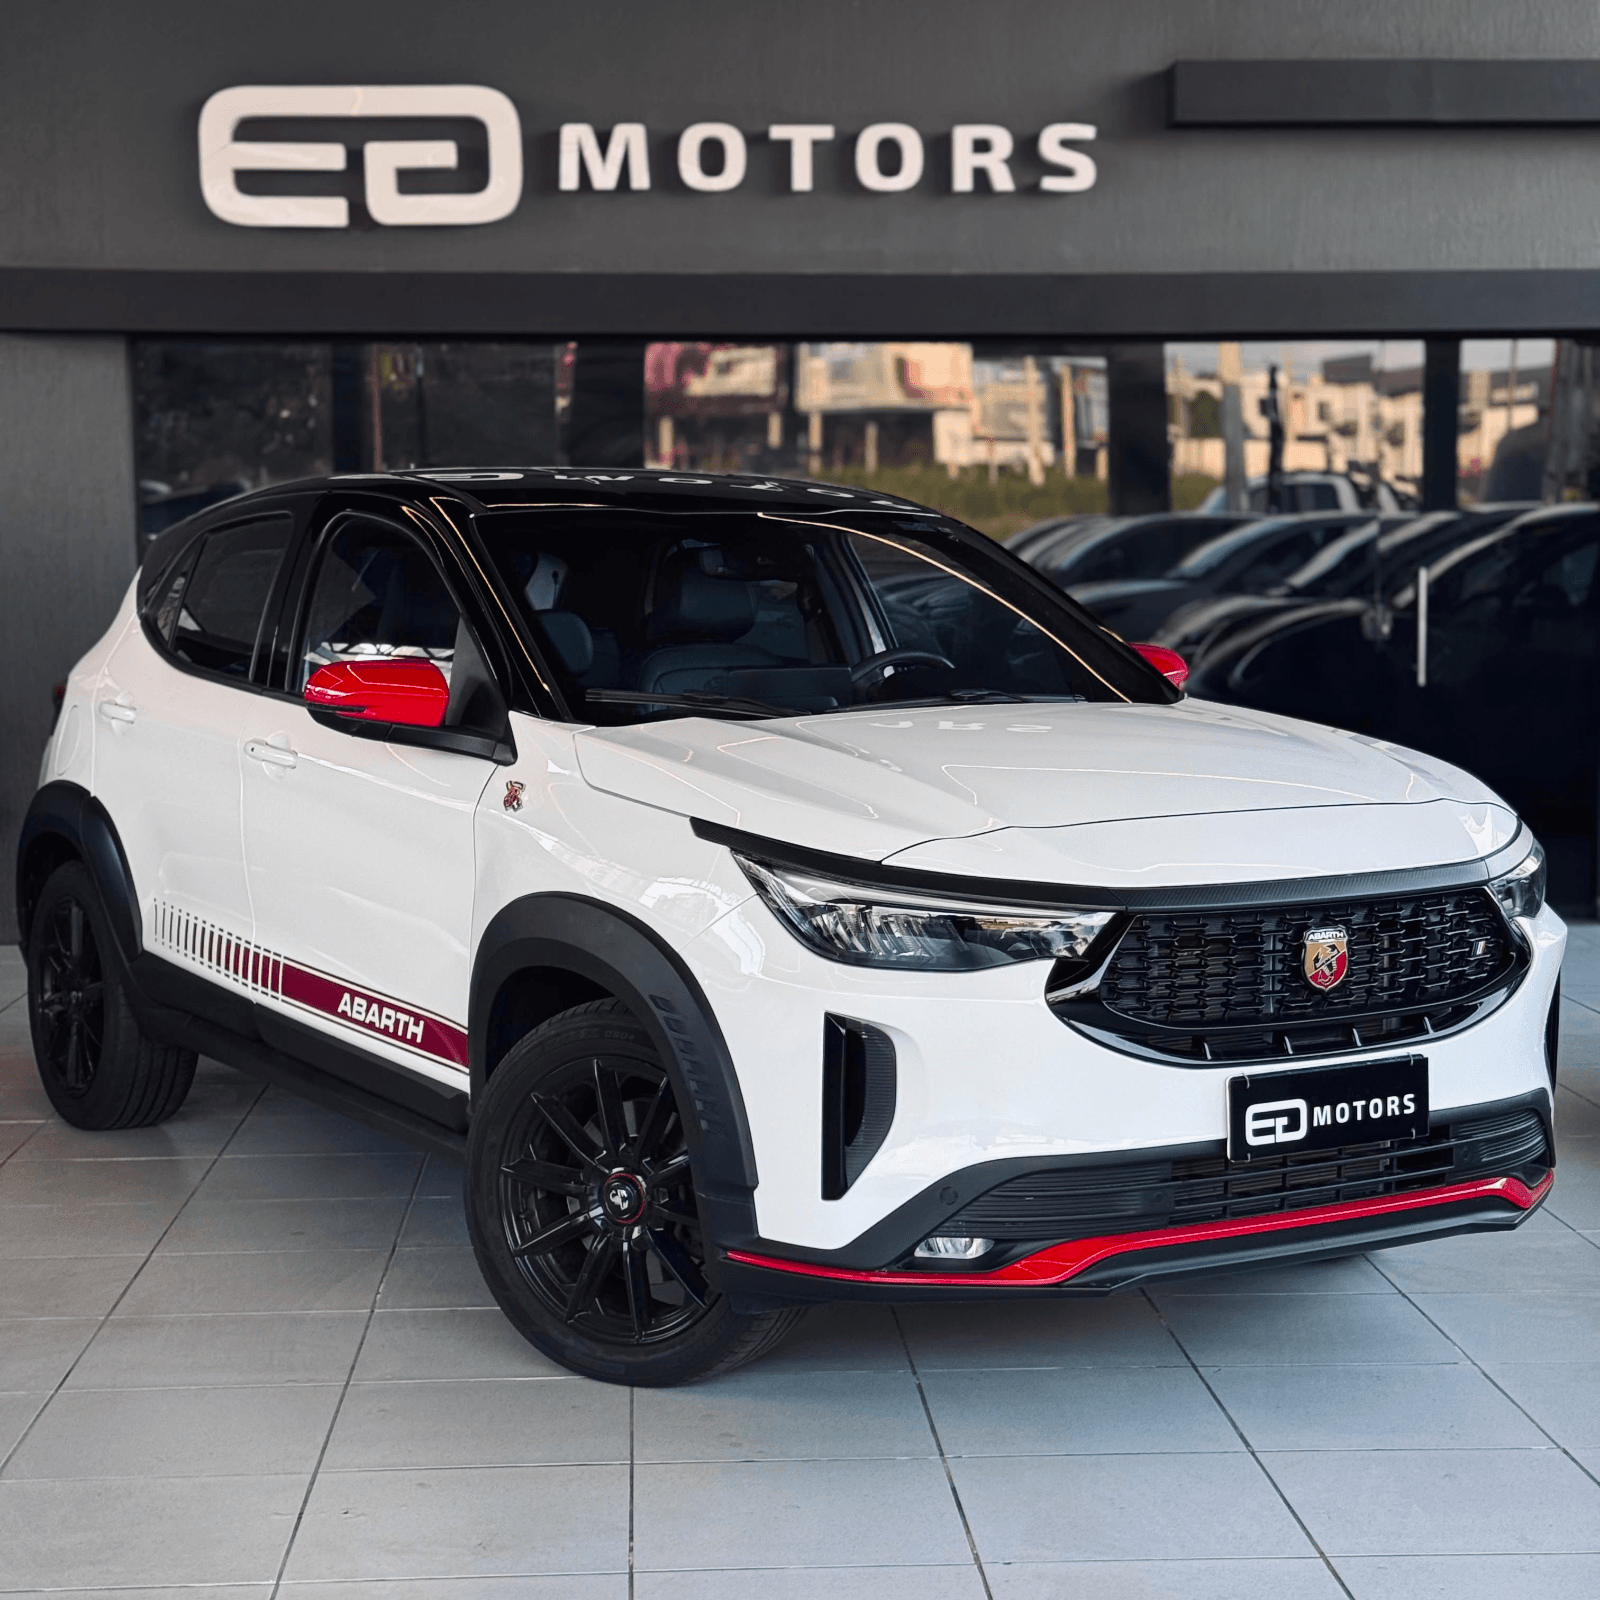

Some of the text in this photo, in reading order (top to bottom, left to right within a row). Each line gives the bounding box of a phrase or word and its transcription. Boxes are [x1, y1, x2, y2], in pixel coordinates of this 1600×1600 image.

[559, 122, 1097, 192] MOTORS
[1308, 931, 1344, 940] ABARTH
[337, 992, 424, 1043] ABARTH
[1312, 1093, 1415, 1127] MOTORS
